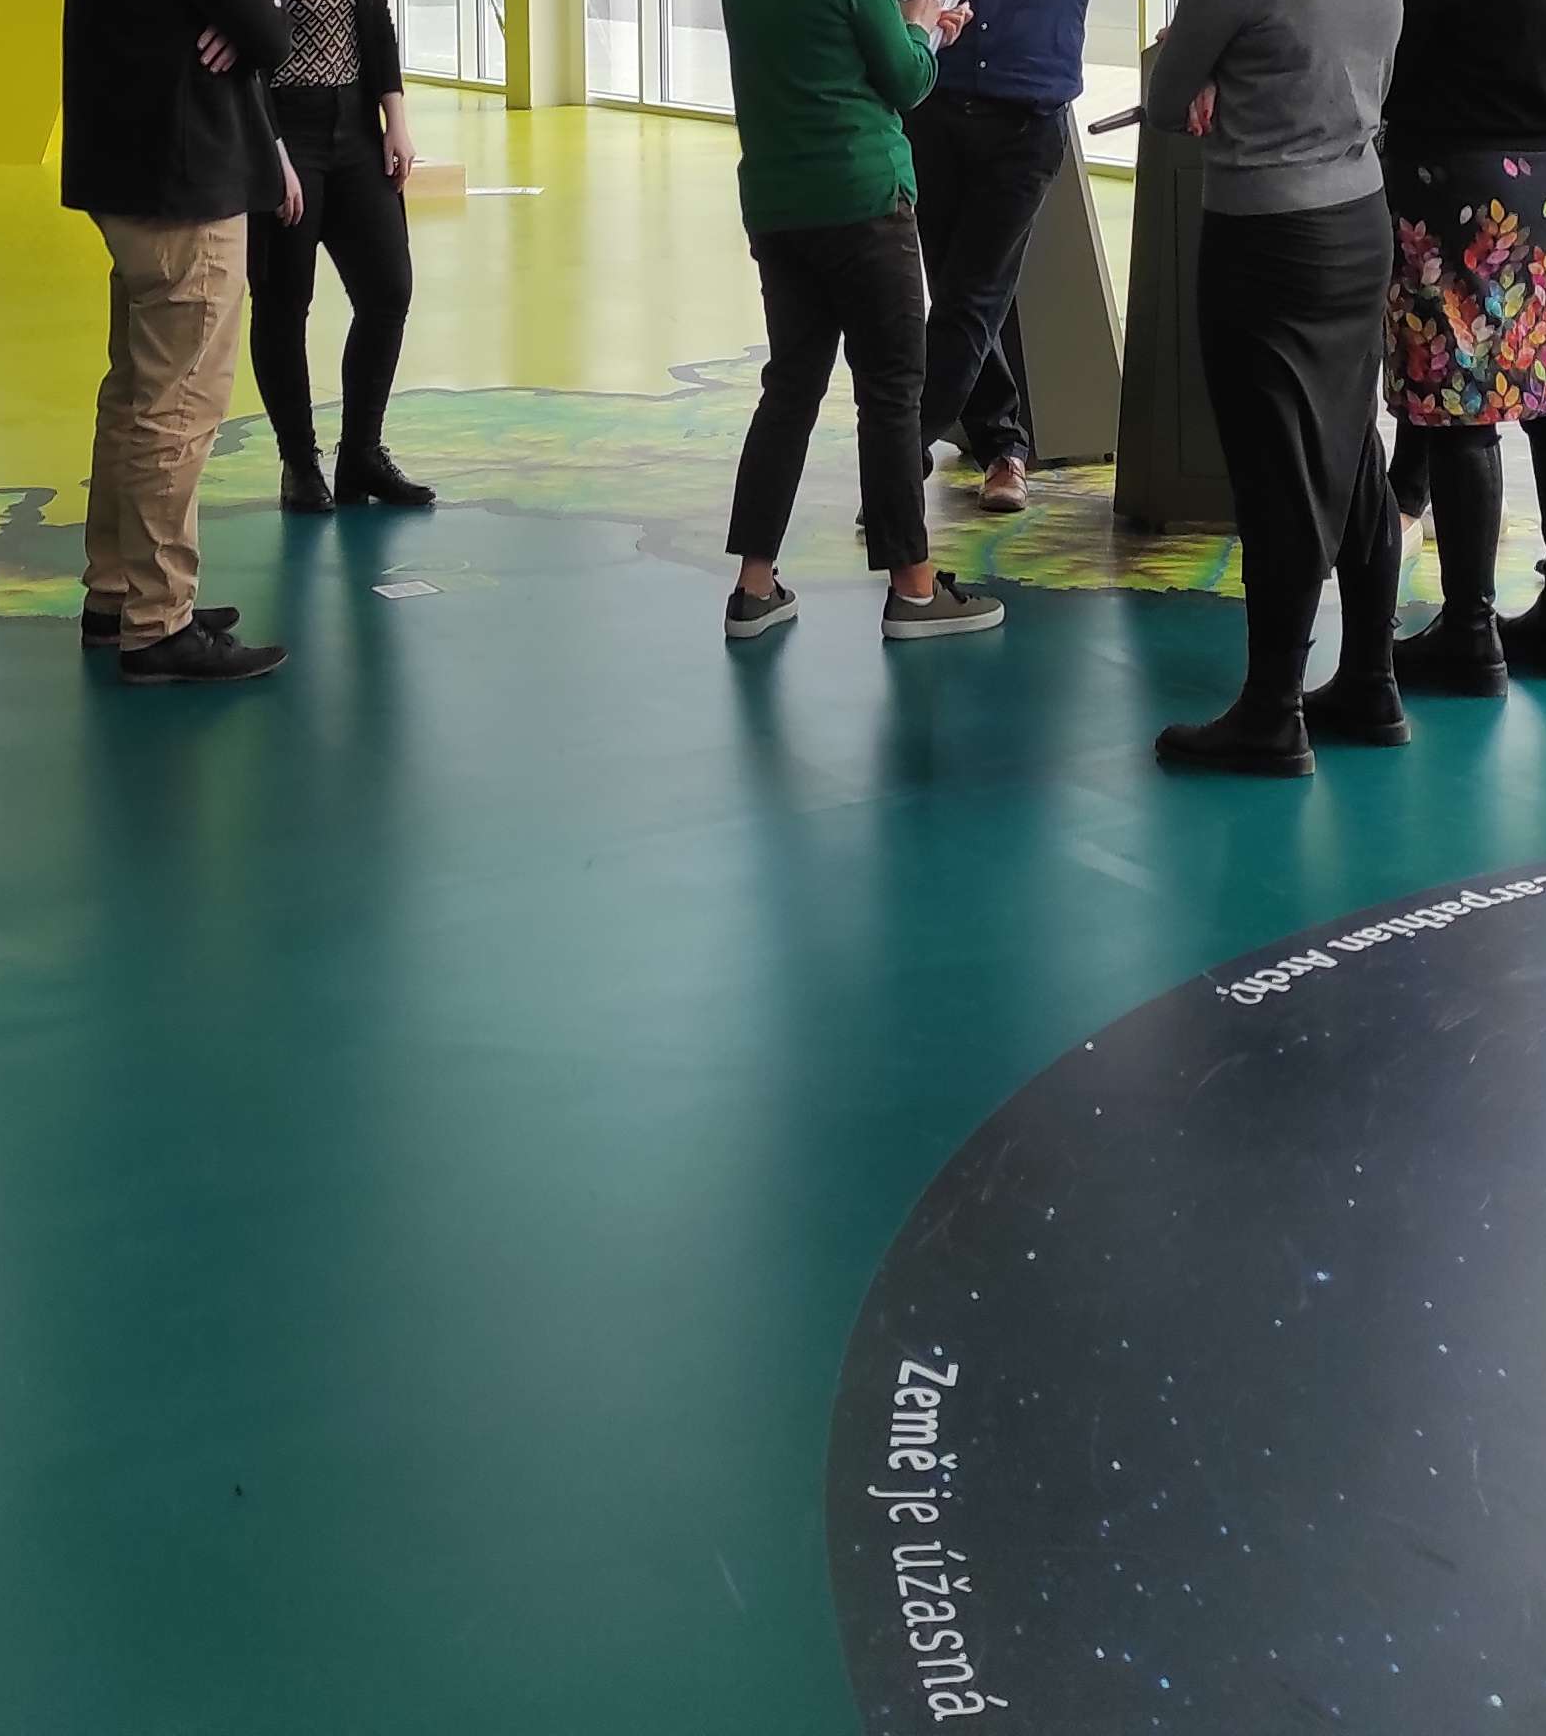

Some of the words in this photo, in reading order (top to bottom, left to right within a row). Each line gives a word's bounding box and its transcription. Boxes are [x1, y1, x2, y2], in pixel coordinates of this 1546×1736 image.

[887, 1358, 960, 1472] Země
[867, 1484, 953, 1525] je
[890, 1538, 1010, 1723] úžasná
